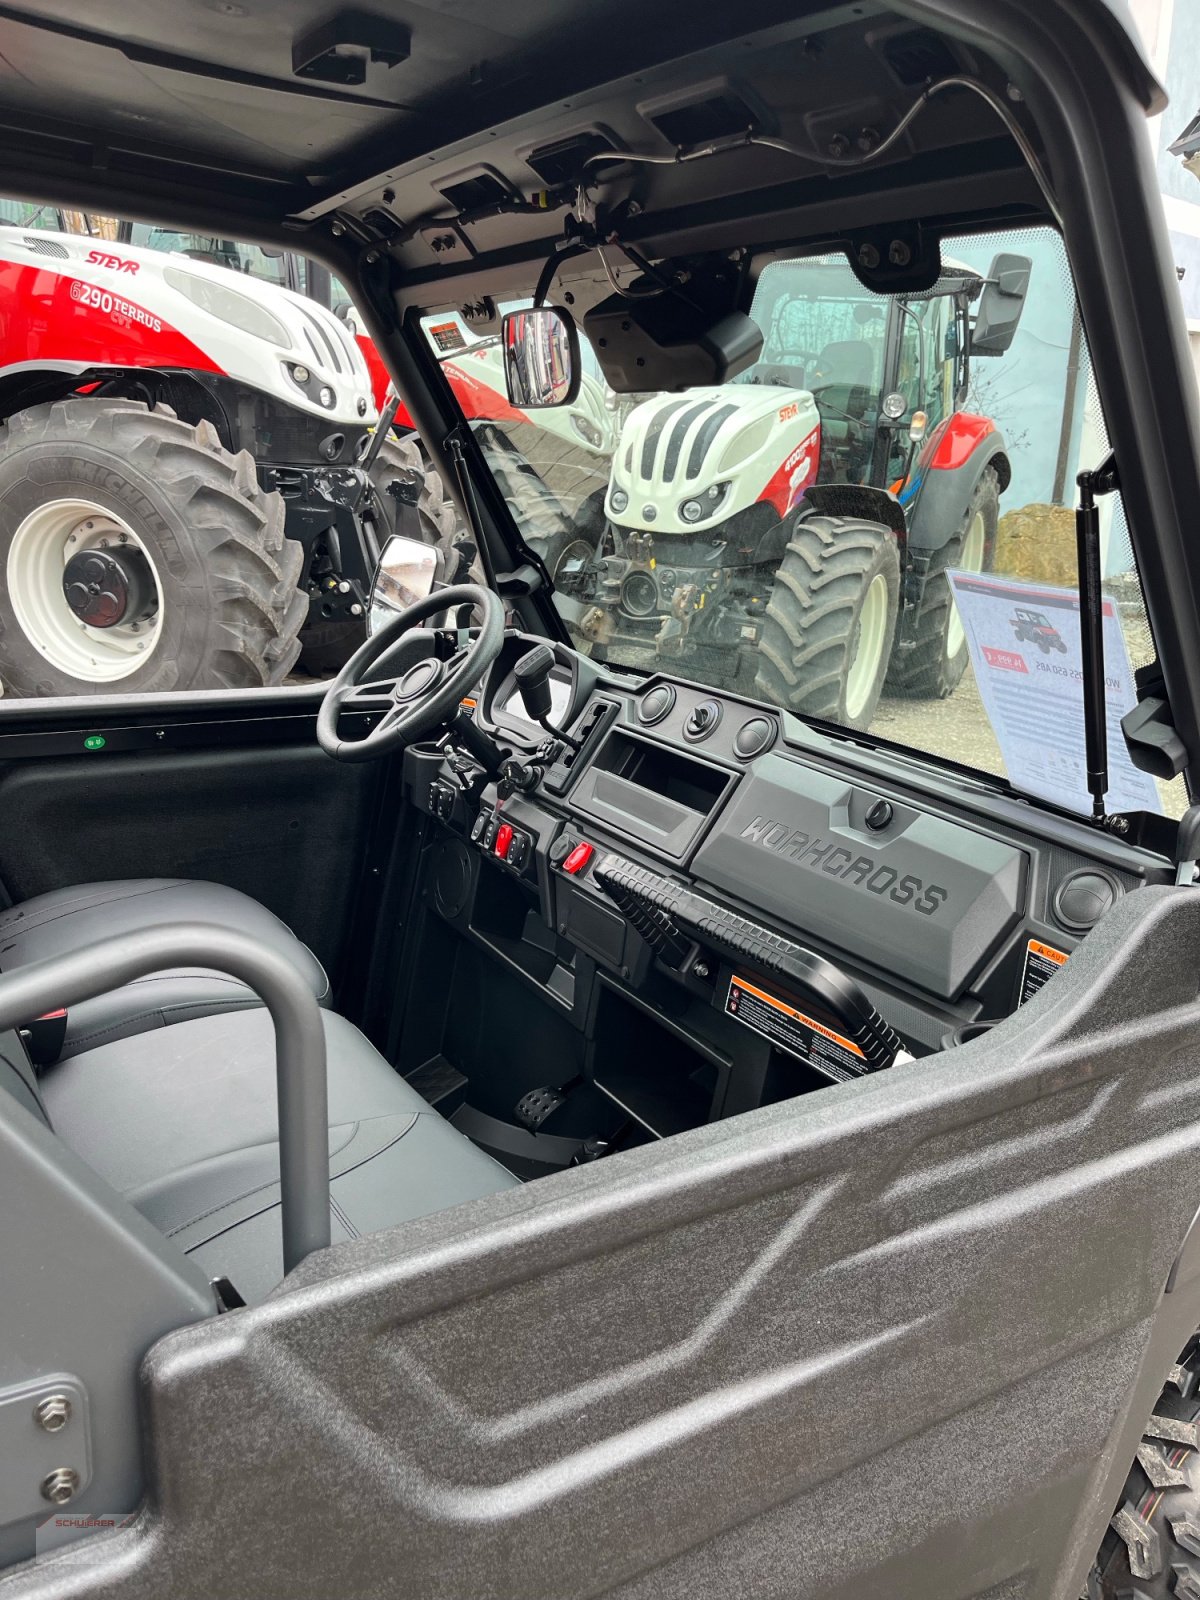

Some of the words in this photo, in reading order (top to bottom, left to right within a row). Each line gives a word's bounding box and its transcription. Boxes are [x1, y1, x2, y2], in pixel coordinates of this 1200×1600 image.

[84, 250, 140, 275] STEYR
[70, 281, 113, 313] 6290
[113, 298, 162, 333] TERRUS
[779, 403, 798, 421] STEYR
[740, 815, 949, 916] WORKCROSS
[802, 1017, 837, 1041] WARNING
